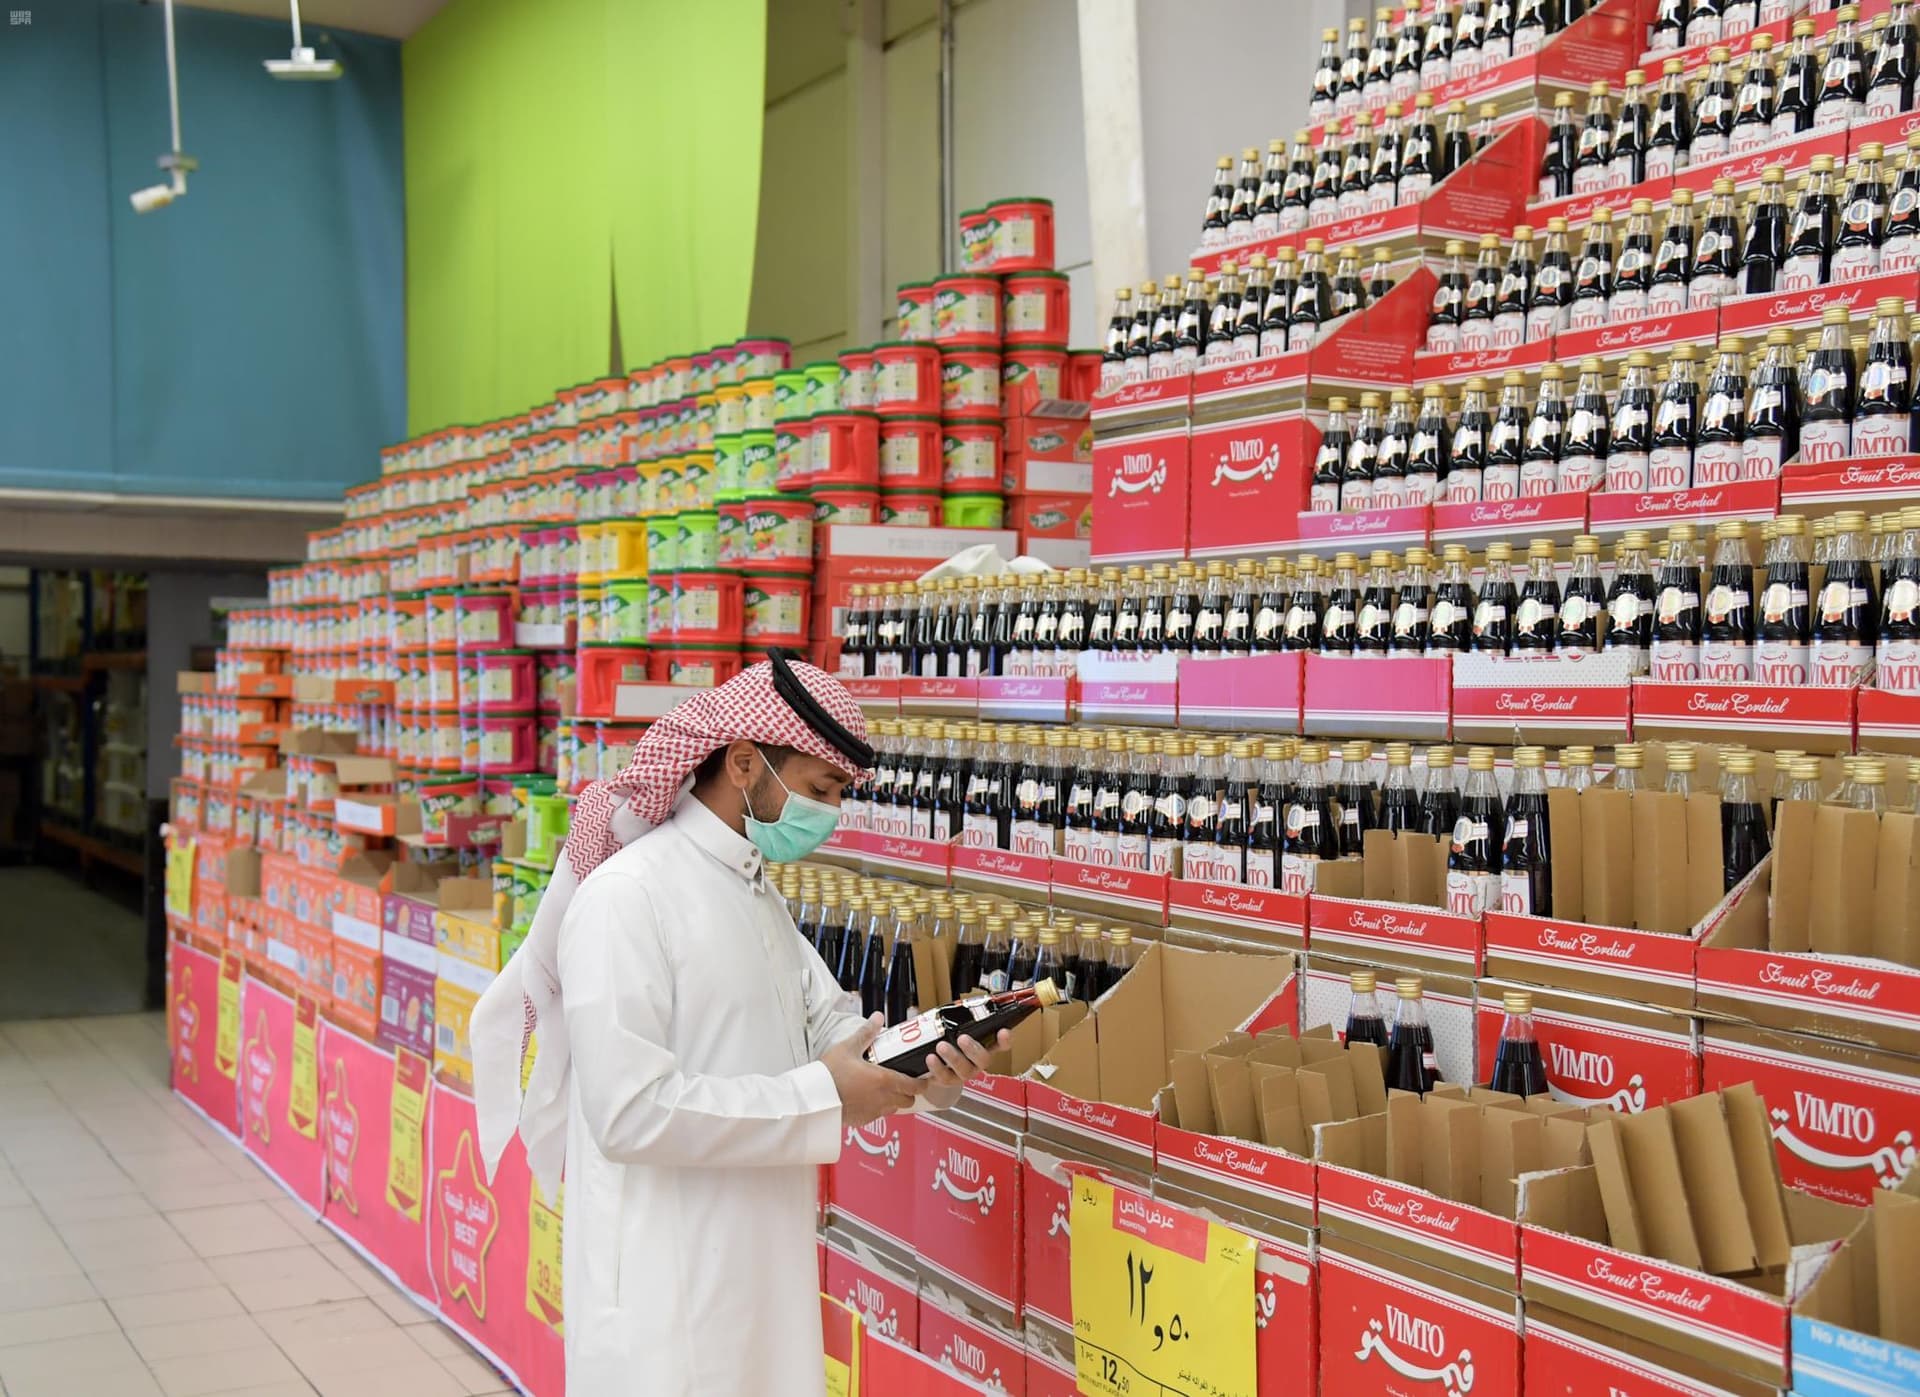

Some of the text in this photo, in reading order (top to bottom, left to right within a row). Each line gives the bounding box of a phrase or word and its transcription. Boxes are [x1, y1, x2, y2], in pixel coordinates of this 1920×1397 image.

[1769, 302, 1807, 318] Fruit
[1123, 454, 1152, 475] VIMTO
[1230, 438, 1264, 462] VIMTO
[1840, 466, 1883, 485] Fruit
[1471, 502, 1542, 522] Fruit Cordial
[1636, 492, 1723, 512] Fruit Cordial
[747, 514, 778, 535] TANG
[1496, 693, 1579, 712] Fruit Cordial
[1688, 692, 1790, 714] Fruit Cordial
[1202, 888, 1265, 913] Fruit Cordial
[1348, 911, 1427, 937] Fruit Cordial
[1538, 927, 1636, 959] Fruit Cordial
[1759, 961, 1881, 1000] Fruit Cordial
[1549, 1042, 1614, 1087] VIMTO
[1793, 1090, 1875, 1143] VIMTO
[949, 1147, 980, 1184] VIMTO
[1194, 1140, 1268, 1176] Fruit Cordial
[1119, 1199, 1174, 1229] عرض خاص
[1367, 1189, 1460, 1233] Fruit Cordial
[857, 1278, 885, 1314] VIMTO
[1587, 1257, 1712, 1313] Fruit Cordial
[1385, 1303, 1445, 1358] VIMTO
[954, 1333, 986, 1374] VIMTO
